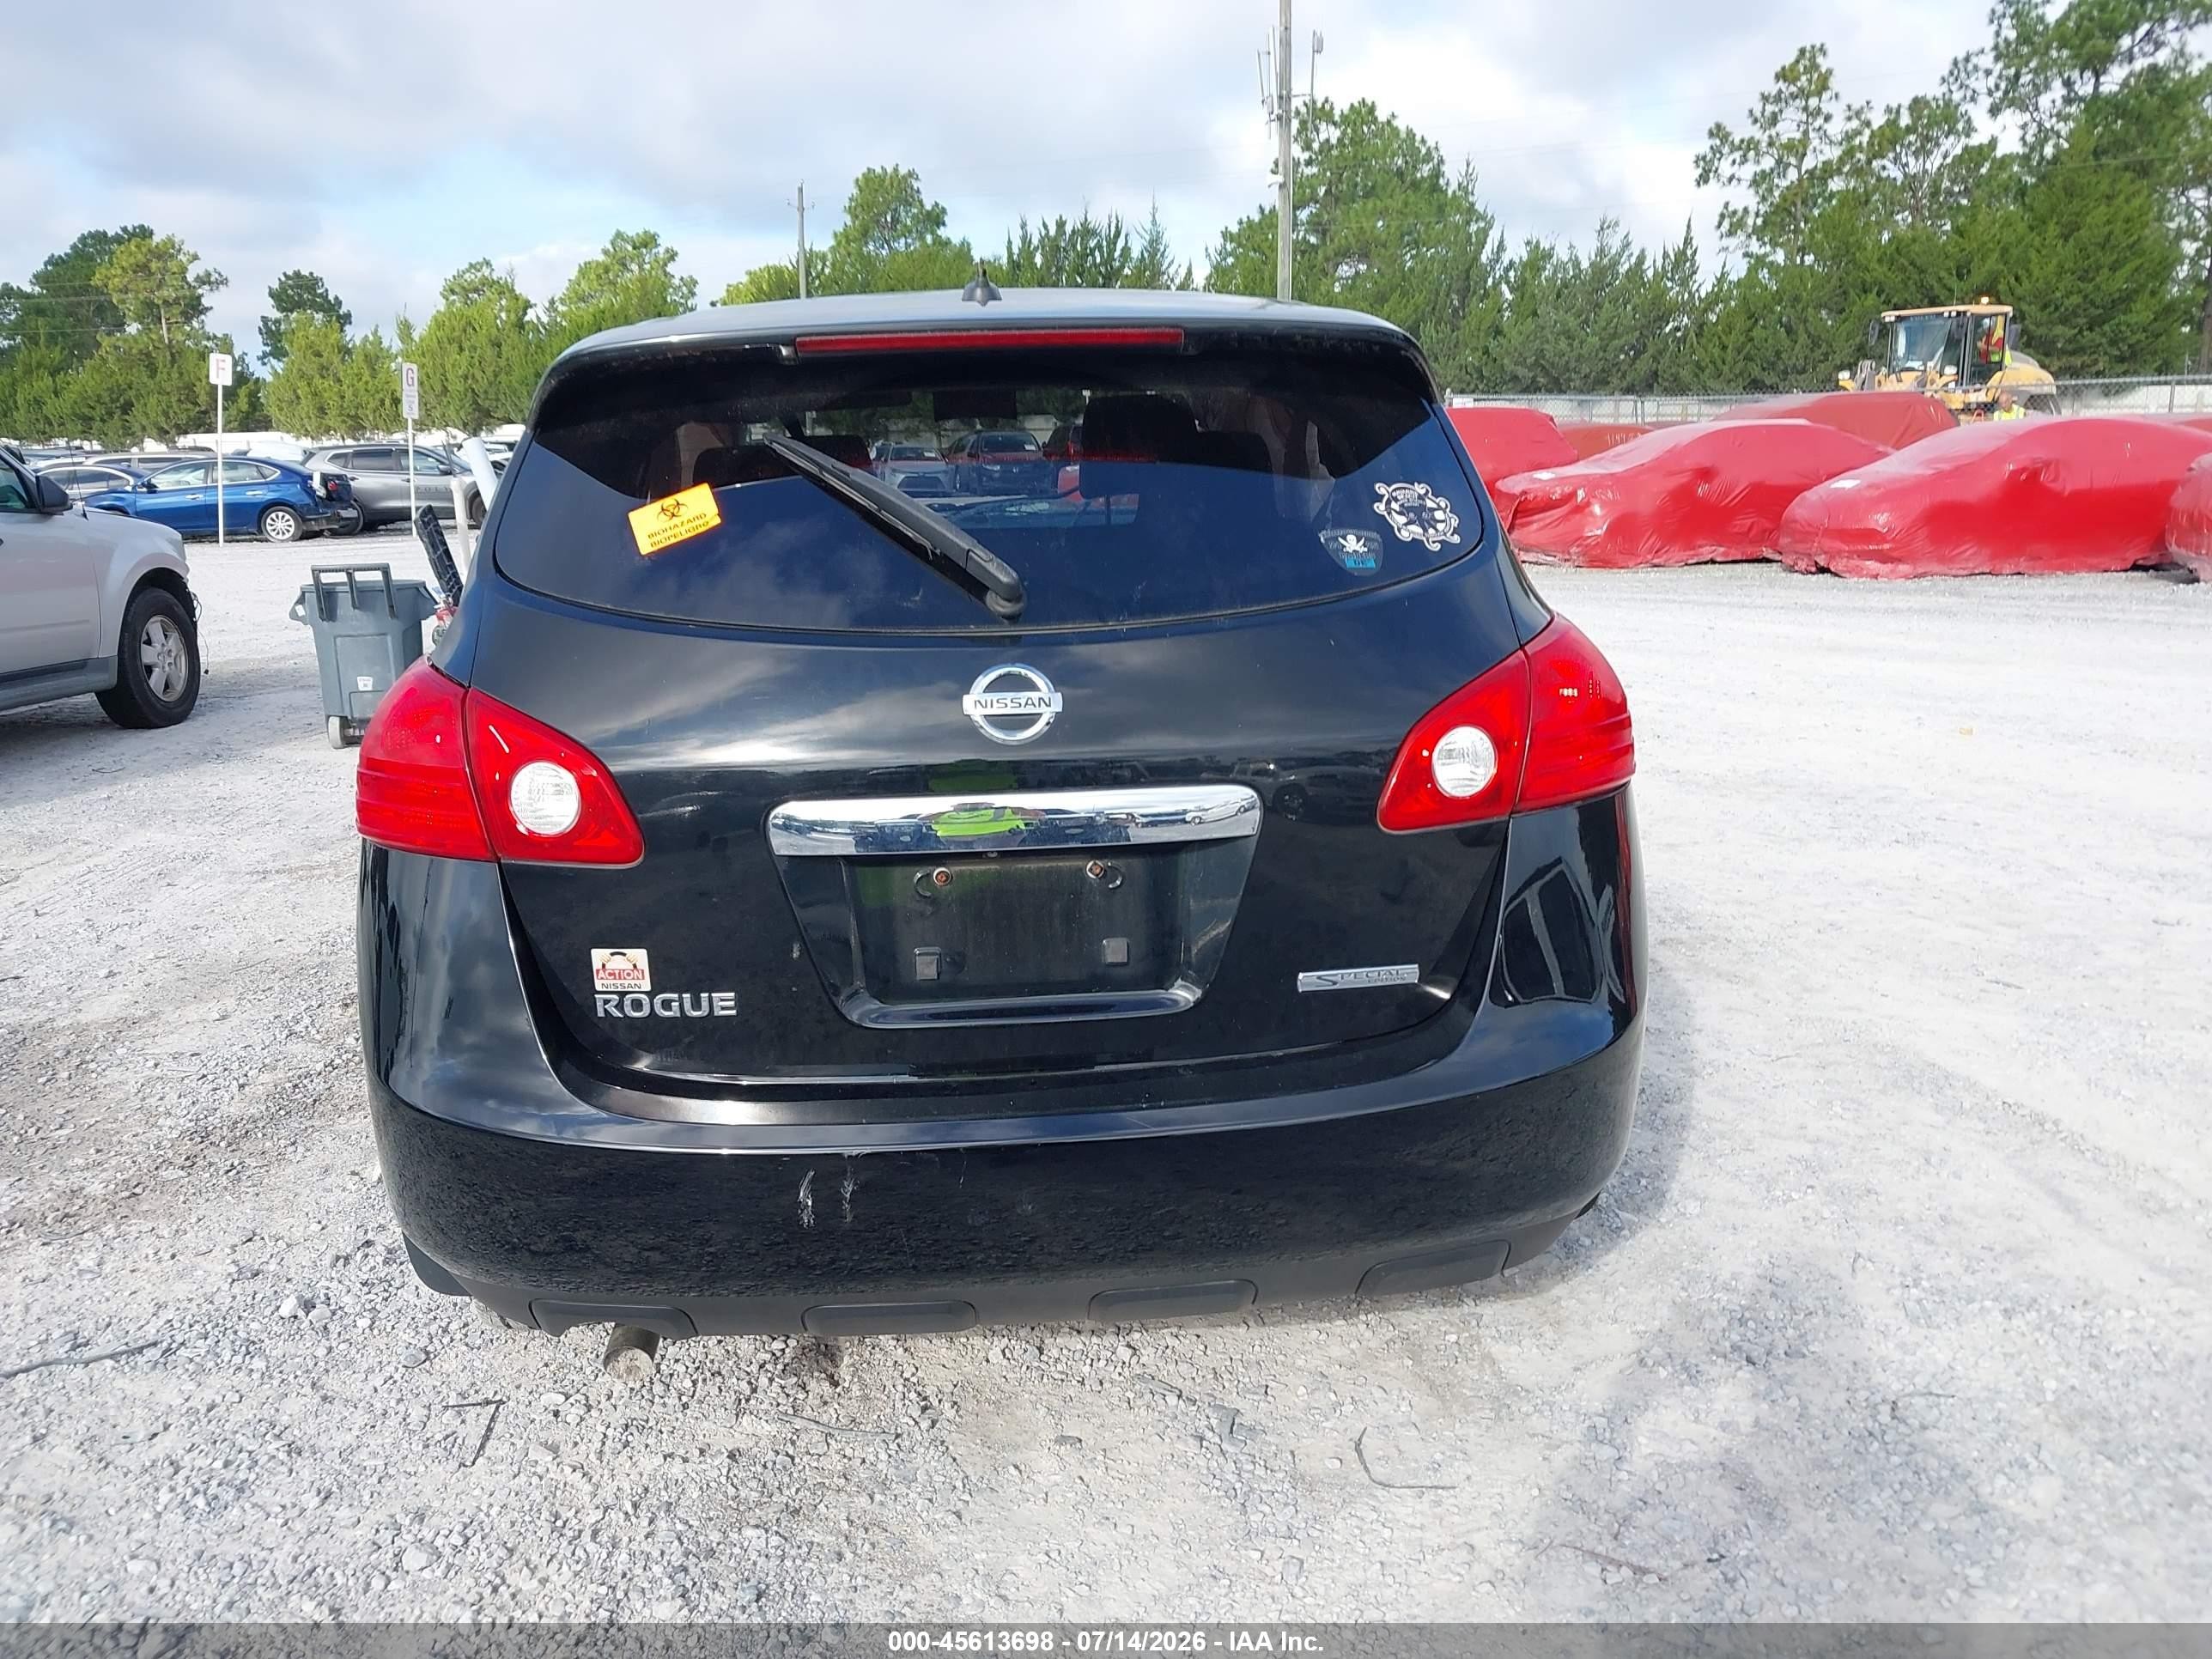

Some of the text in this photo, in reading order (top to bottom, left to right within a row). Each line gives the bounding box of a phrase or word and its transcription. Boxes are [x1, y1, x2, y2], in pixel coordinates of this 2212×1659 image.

[216, 358, 226, 379] F
[406, 368, 415, 386] G
[647, 513, 707, 540] BIOHAZARD
[650, 520, 709, 548] BIOPELIGRO
[974, 696, 1052, 709] NISSAN
[597, 969, 643, 980] ACTION
[1316, 969, 1401, 988] SPECIAL
[594, 992, 737, 1018] ROGUE
